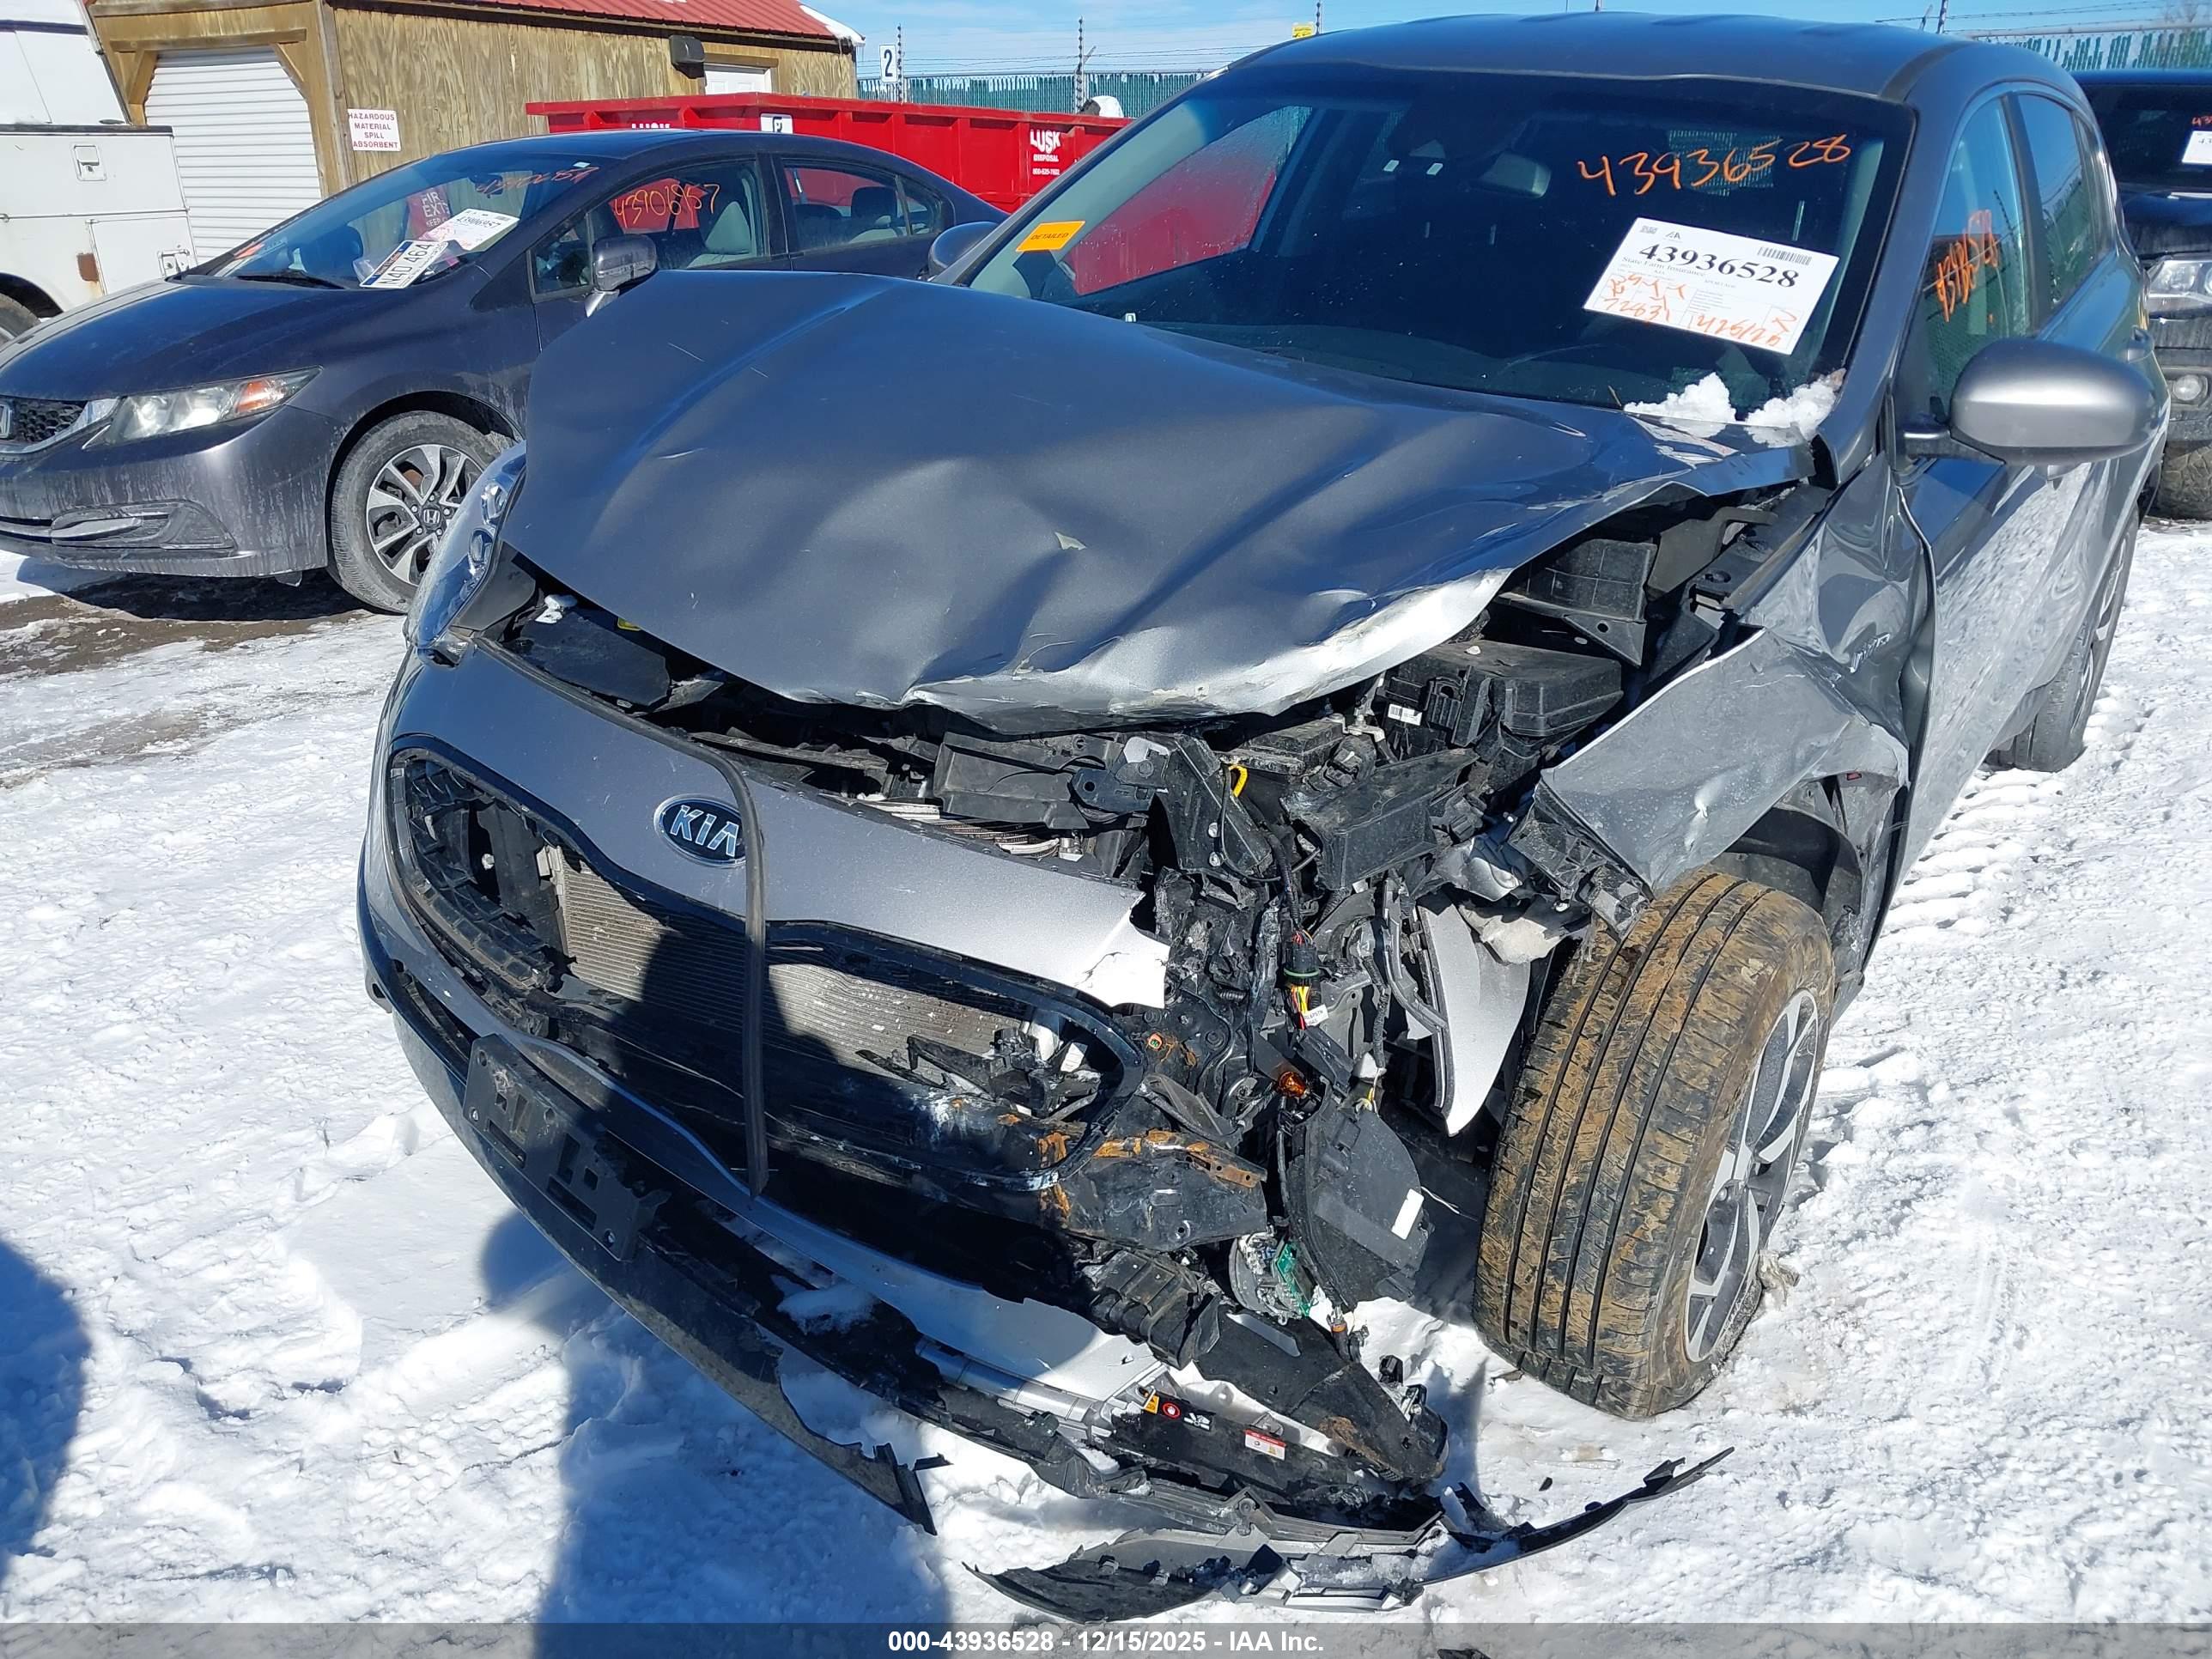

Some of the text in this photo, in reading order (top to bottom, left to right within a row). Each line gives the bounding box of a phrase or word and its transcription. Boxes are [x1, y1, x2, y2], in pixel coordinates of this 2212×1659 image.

[884, 48, 894, 77] 2
[349, 112, 395, 121] HAZARDOUS
[354, 122, 392, 131] MATERIAL
[353, 140, 398, 149] ABSORBENT
[1030, 129, 1061, 155] LUSK
[1033, 154, 1060, 162] DISPOSAL
[1577, 133, 1851, 196] 43936528
[1030, 232, 1071, 240] DETAILED
[1622, 257, 1643, 265] State
[1644, 260, 1665, 270] Farm
[1667, 264, 1705, 276] Insurance
[1638, 243, 1800, 289] 43936528
[670, 805, 739, 857] KIA
